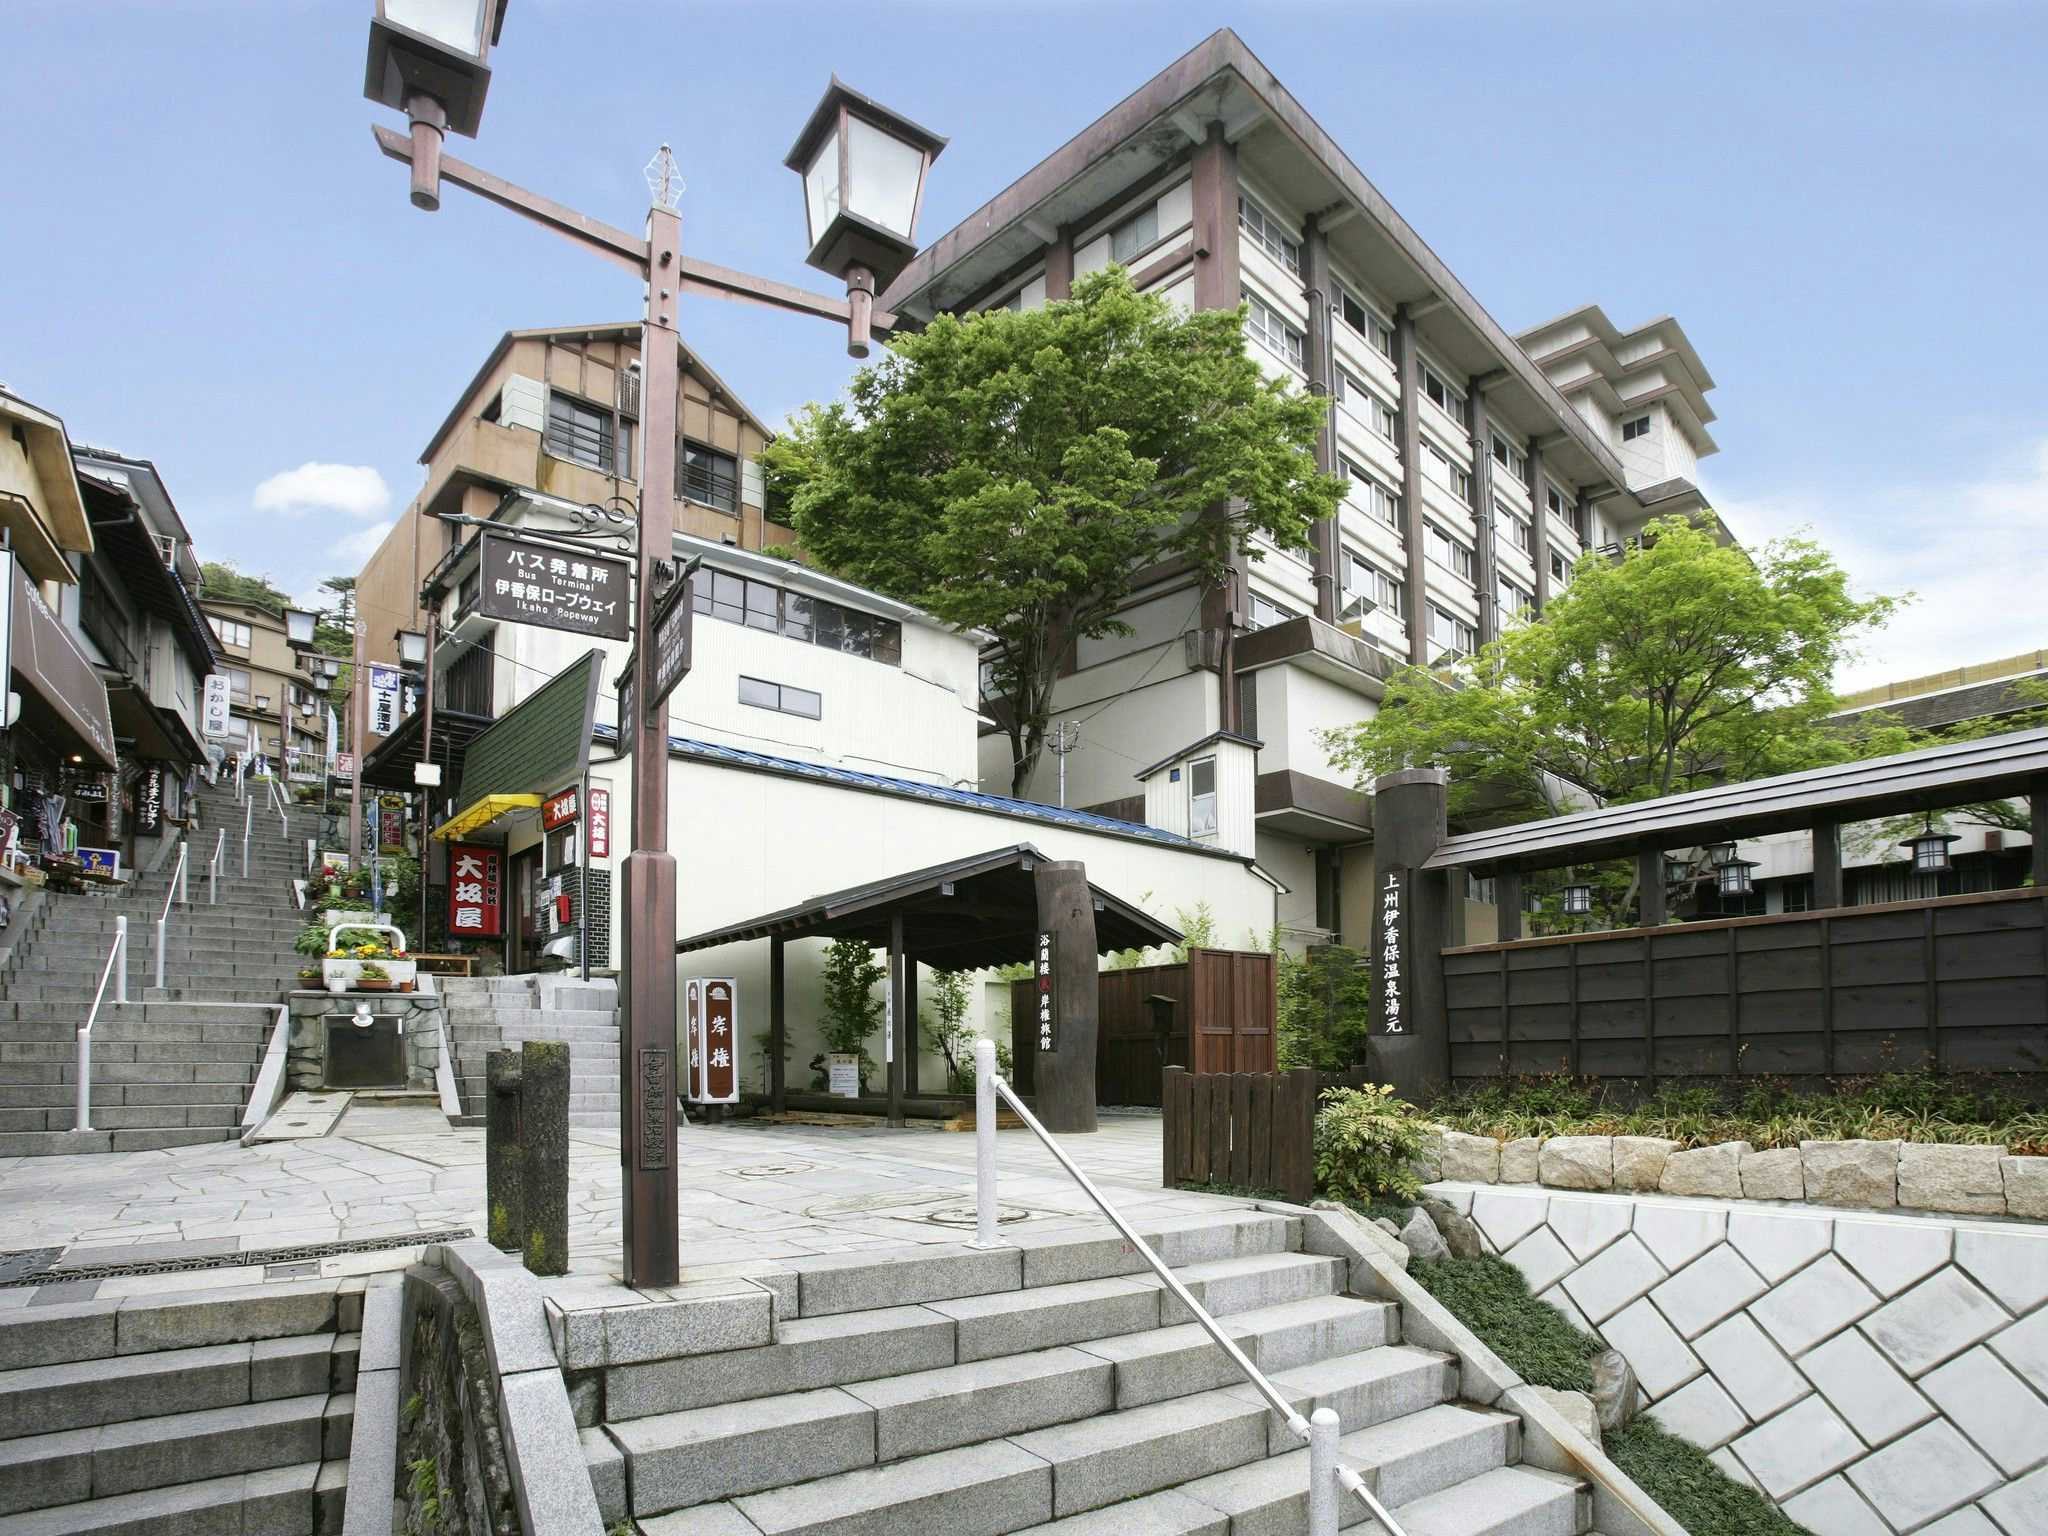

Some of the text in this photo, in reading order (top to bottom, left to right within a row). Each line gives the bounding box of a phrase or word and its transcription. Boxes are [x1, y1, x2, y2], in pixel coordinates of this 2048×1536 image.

[507, 550, 609, 584] バス発着所
[518, 569, 594, 592] Bus Terminal
[516, 600, 600, 624] Ikaho Ropeway
[209, 680, 224, 731] おかし屋
[376, 691, 391, 731] 土屋酒店
[1383, 873, 1402, 1033] 上州伊香保温泉湯元
